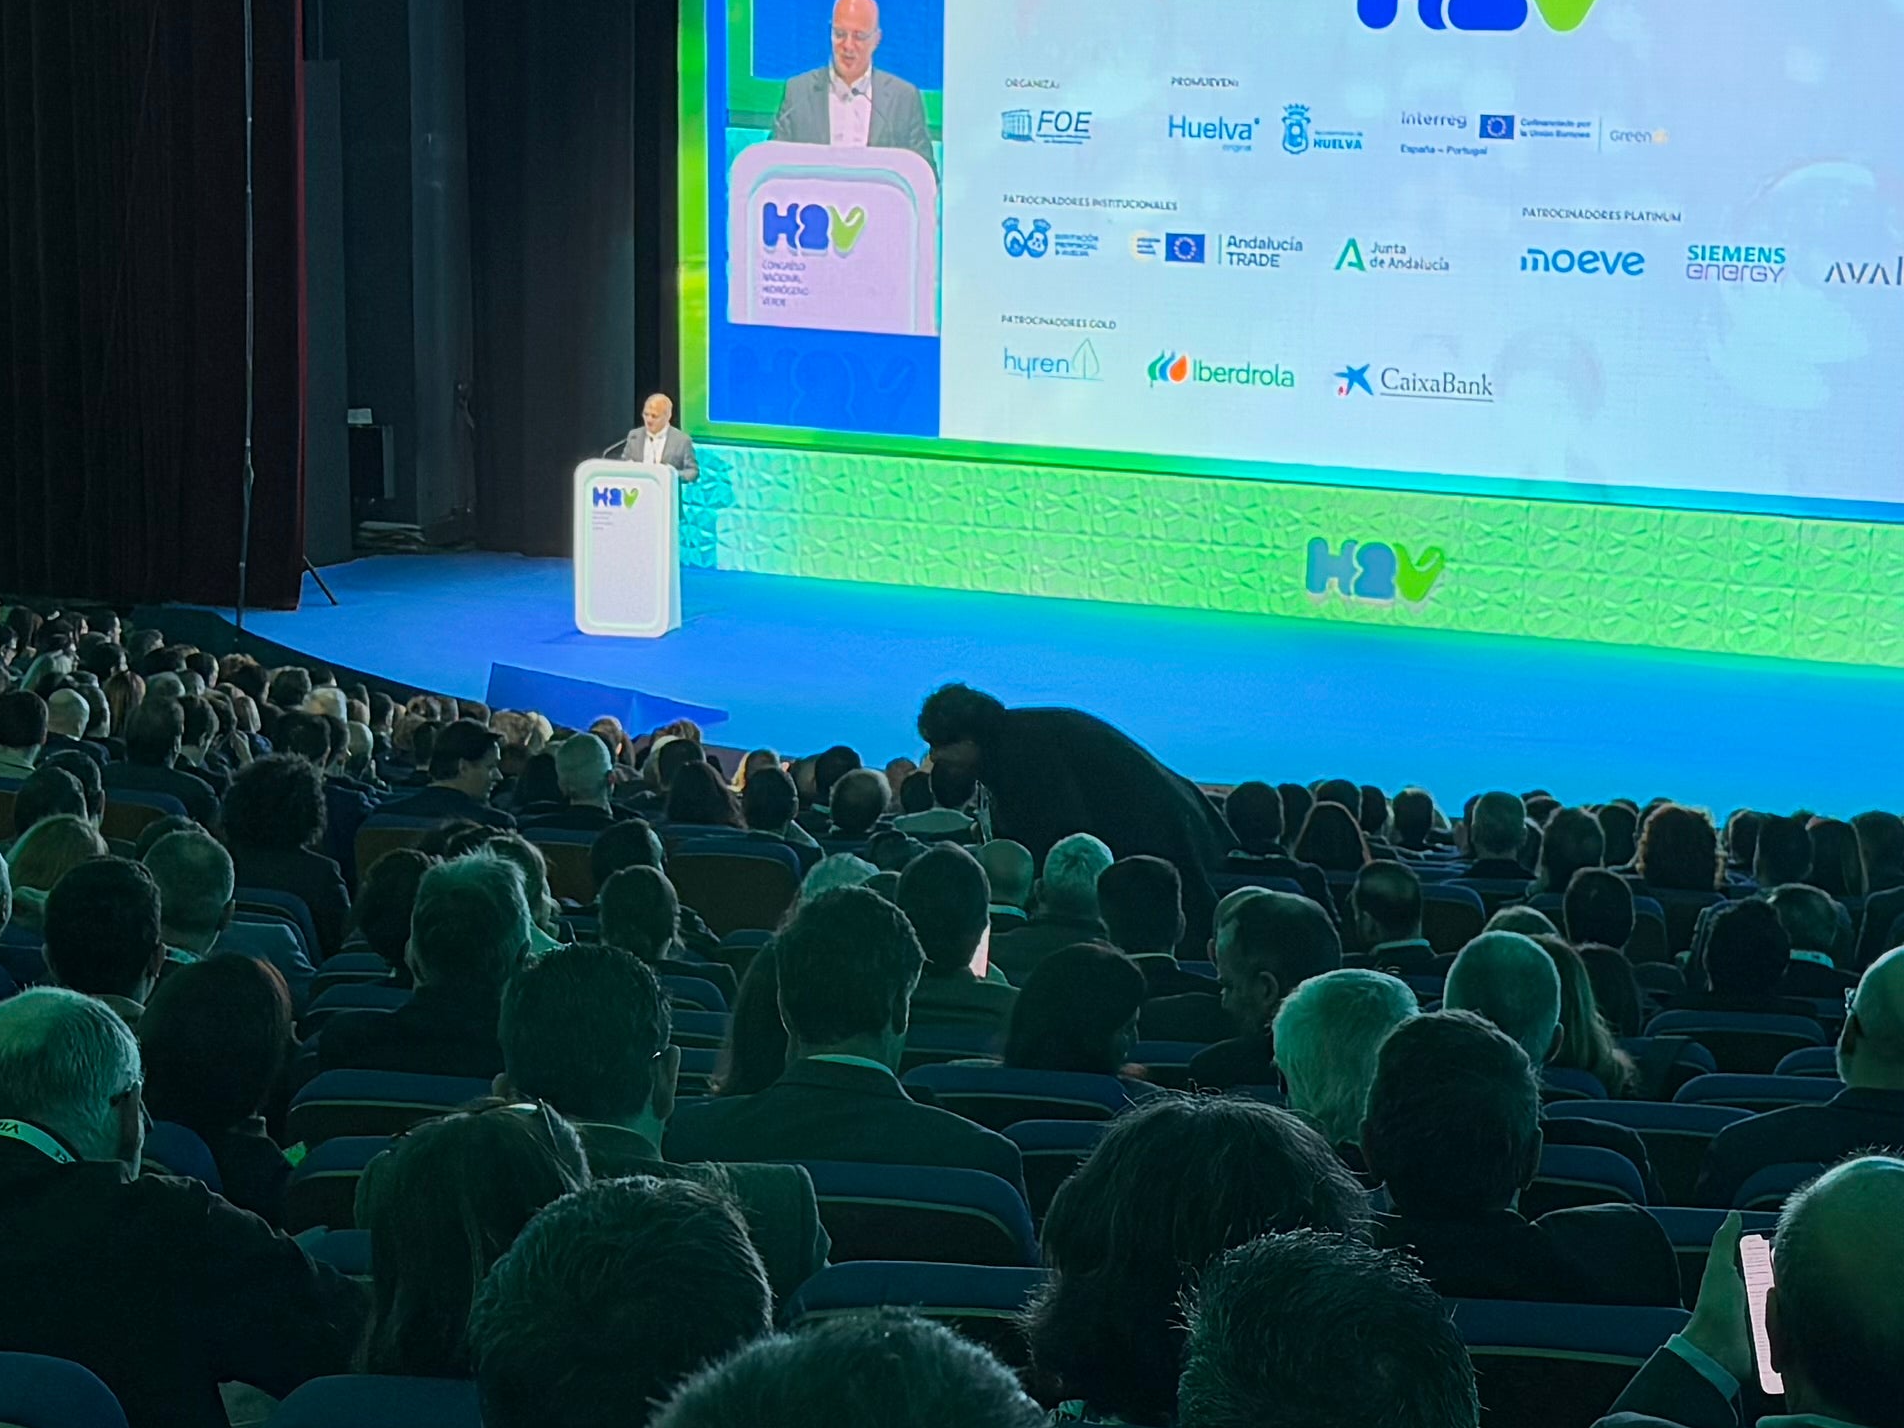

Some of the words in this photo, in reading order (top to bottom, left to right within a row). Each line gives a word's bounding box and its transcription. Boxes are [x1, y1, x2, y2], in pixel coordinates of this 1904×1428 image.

[1037, 110, 1093, 133] FOE
[1168, 114, 1252, 140] Huelva
[1400, 112, 1468, 130] Interreg
[1624, 209, 1682, 222] PLATINUM
[1226, 235, 1304, 252] Andalucía
[1370, 241, 1407, 255] Junta
[1226, 252, 1281, 268] TRADE
[1370, 256, 1386, 269] de
[1388, 256, 1450, 271] Andalucía
[1520, 248, 1645, 276] moeve
[1687, 245, 1786, 264] SIEMENS
[1004, 348, 1070, 379] hyren
[1193, 359, 1295, 387] Iberdrola
[1380, 367, 1493, 396] CaixaBank
